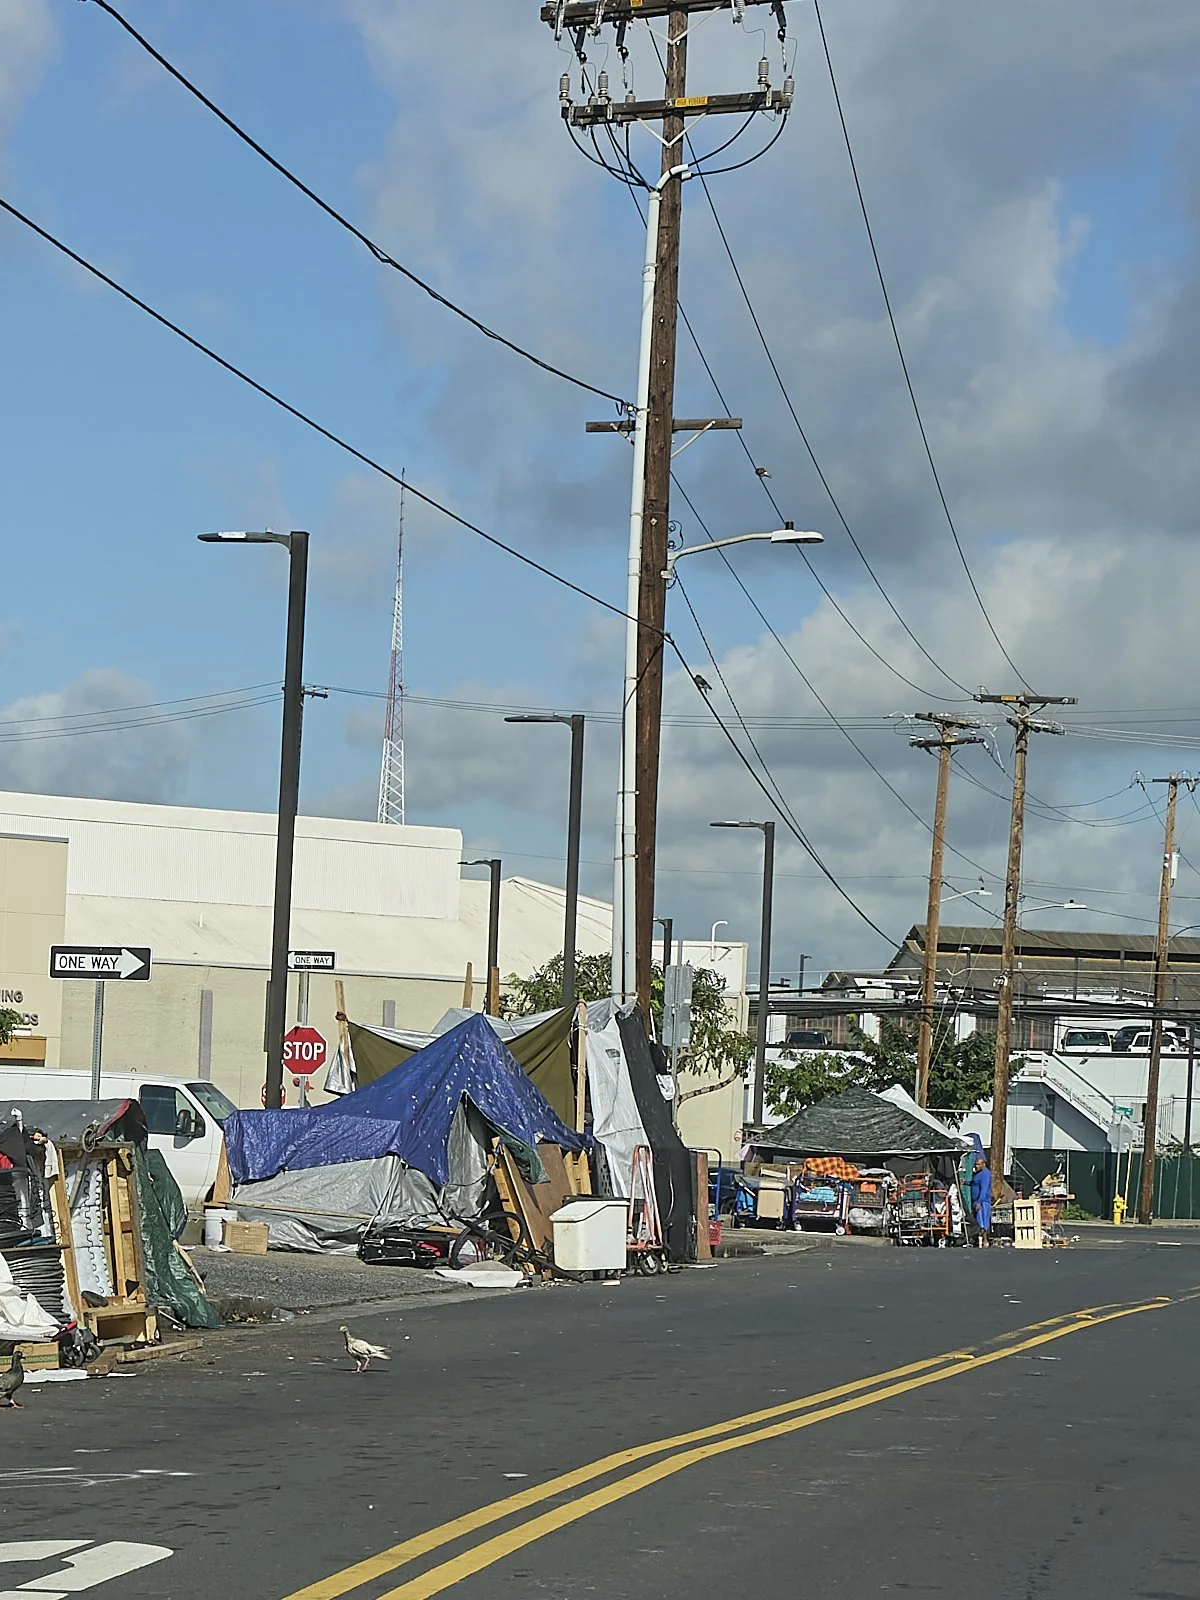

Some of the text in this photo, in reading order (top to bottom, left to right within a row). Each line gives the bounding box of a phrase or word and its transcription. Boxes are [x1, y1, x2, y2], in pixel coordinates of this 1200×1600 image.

[59, 955, 119, 970] ONE WAY
[295, 956, 330, 965] ONE WAY
[283, 1041, 325, 1061] STOP
